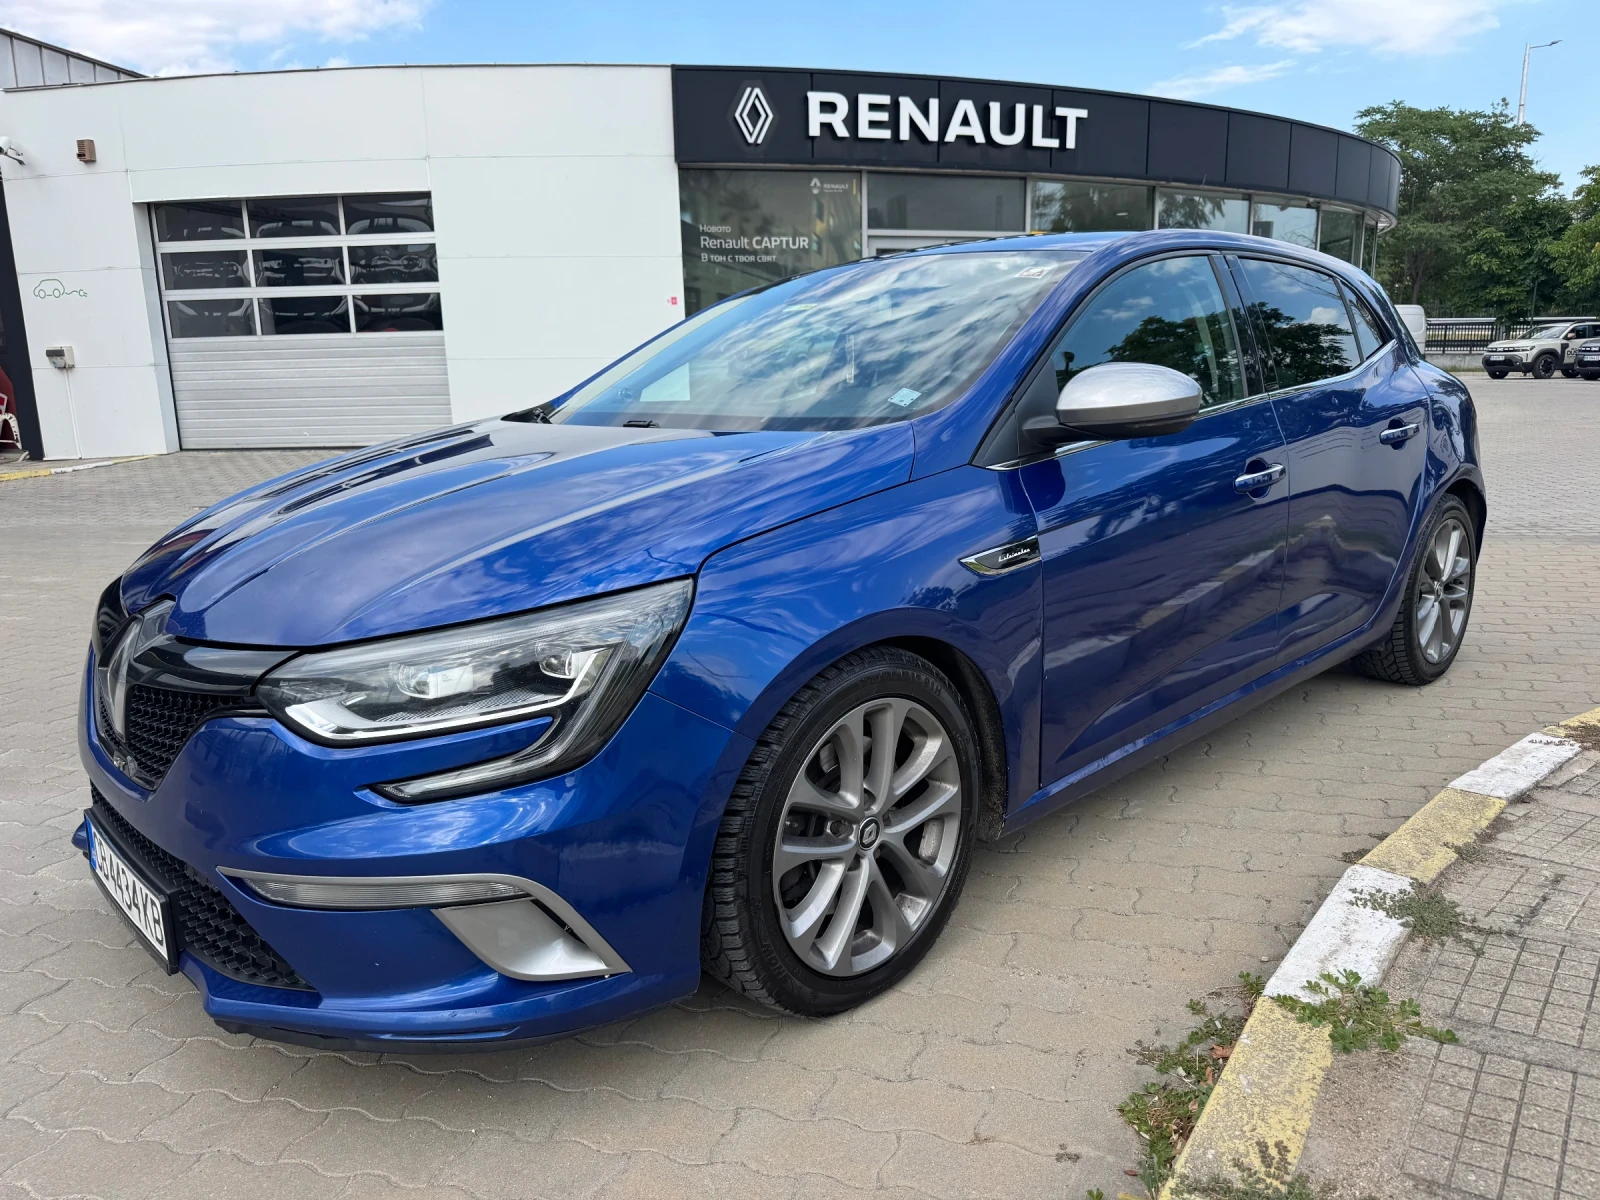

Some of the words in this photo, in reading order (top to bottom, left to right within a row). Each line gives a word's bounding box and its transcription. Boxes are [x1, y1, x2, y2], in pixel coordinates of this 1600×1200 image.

[806, 90, 1089, 150] RENAULT
[699, 224, 731, 233] Новото
[700, 236, 750, 249] Renault
[752, 236, 809, 249] CAPTUR
[701, 252, 709, 262] В
